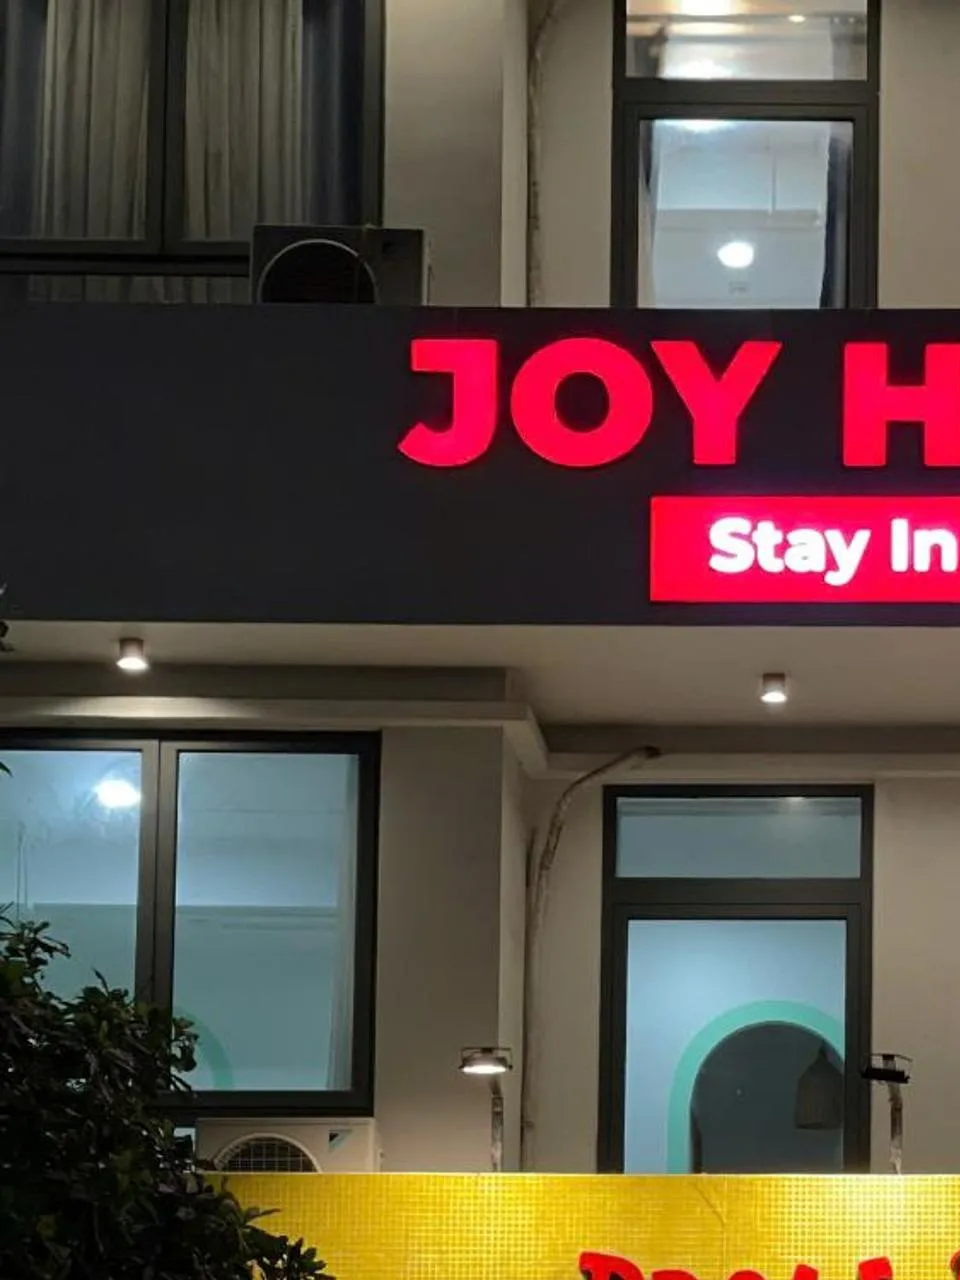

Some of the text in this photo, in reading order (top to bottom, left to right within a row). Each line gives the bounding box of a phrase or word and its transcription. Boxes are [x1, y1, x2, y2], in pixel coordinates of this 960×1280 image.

[399, 337, 780, 468] JOY
[708, 516, 871, 586] Stay
[891, 518, 958, 572] In
